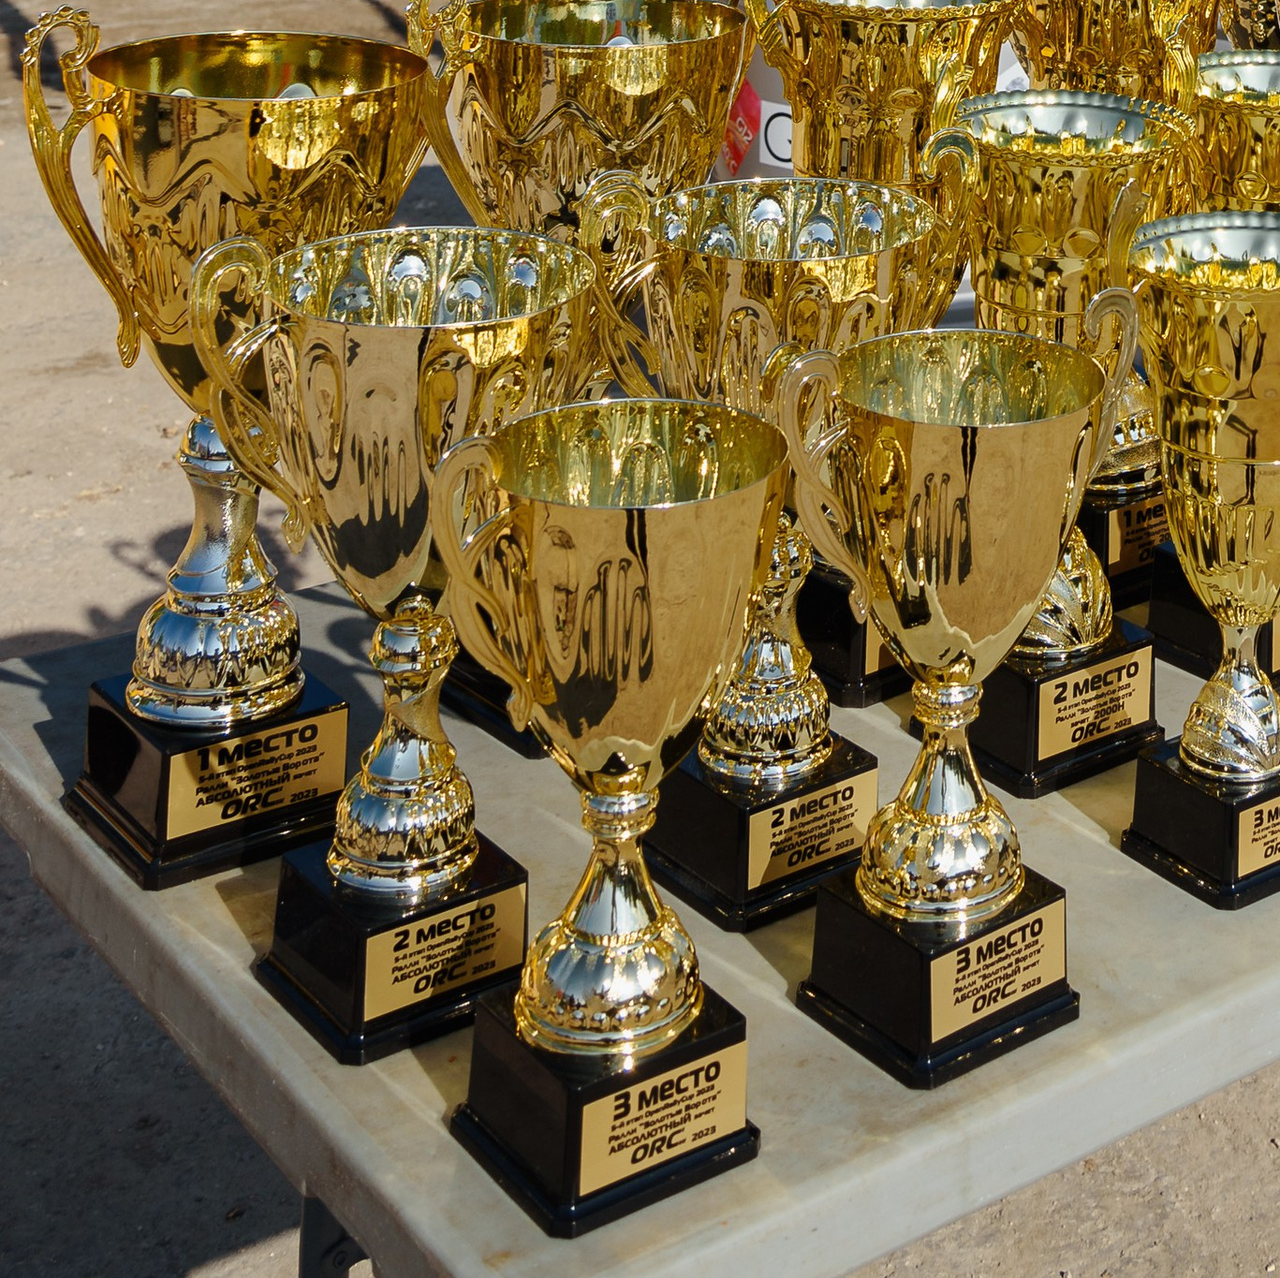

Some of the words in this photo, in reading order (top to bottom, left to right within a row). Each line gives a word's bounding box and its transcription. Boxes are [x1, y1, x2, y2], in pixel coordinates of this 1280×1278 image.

[1053, 681, 1067, 703] 2
[1072, 660, 1139, 698] место
[197, 748, 210, 771] 1
[216, 723, 318, 765] место
[1071, 716, 1110, 742] ORC
[221, 788, 284, 819] ORC
[289, 788, 317, 803] 2023
[771, 808, 784, 828] 2
[789, 785, 854, 821] место
[1254, 808, 1263, 828] 3
[787, 839, 830, 866] ORC
[834, 838, 853, 851] 2023
[393, 929, 410, 952] 2
[415, 902, 496, 943] место
[956, 946, 970, 973] 3
[976, 917, 1043, 963] место
[413, 962, 466, 992] ORC
[470, 960, 494, 975] 2023
[972, 980, 1017, 1012] ORC
[1021, 976, 1041, 991] 2023
[613, 1091, 631, 1120] 3
[637, 1060, 720, 1110] место
[631, 1129, 686, 1163] ORC
[691, 1125, 716, 1142] 2023
